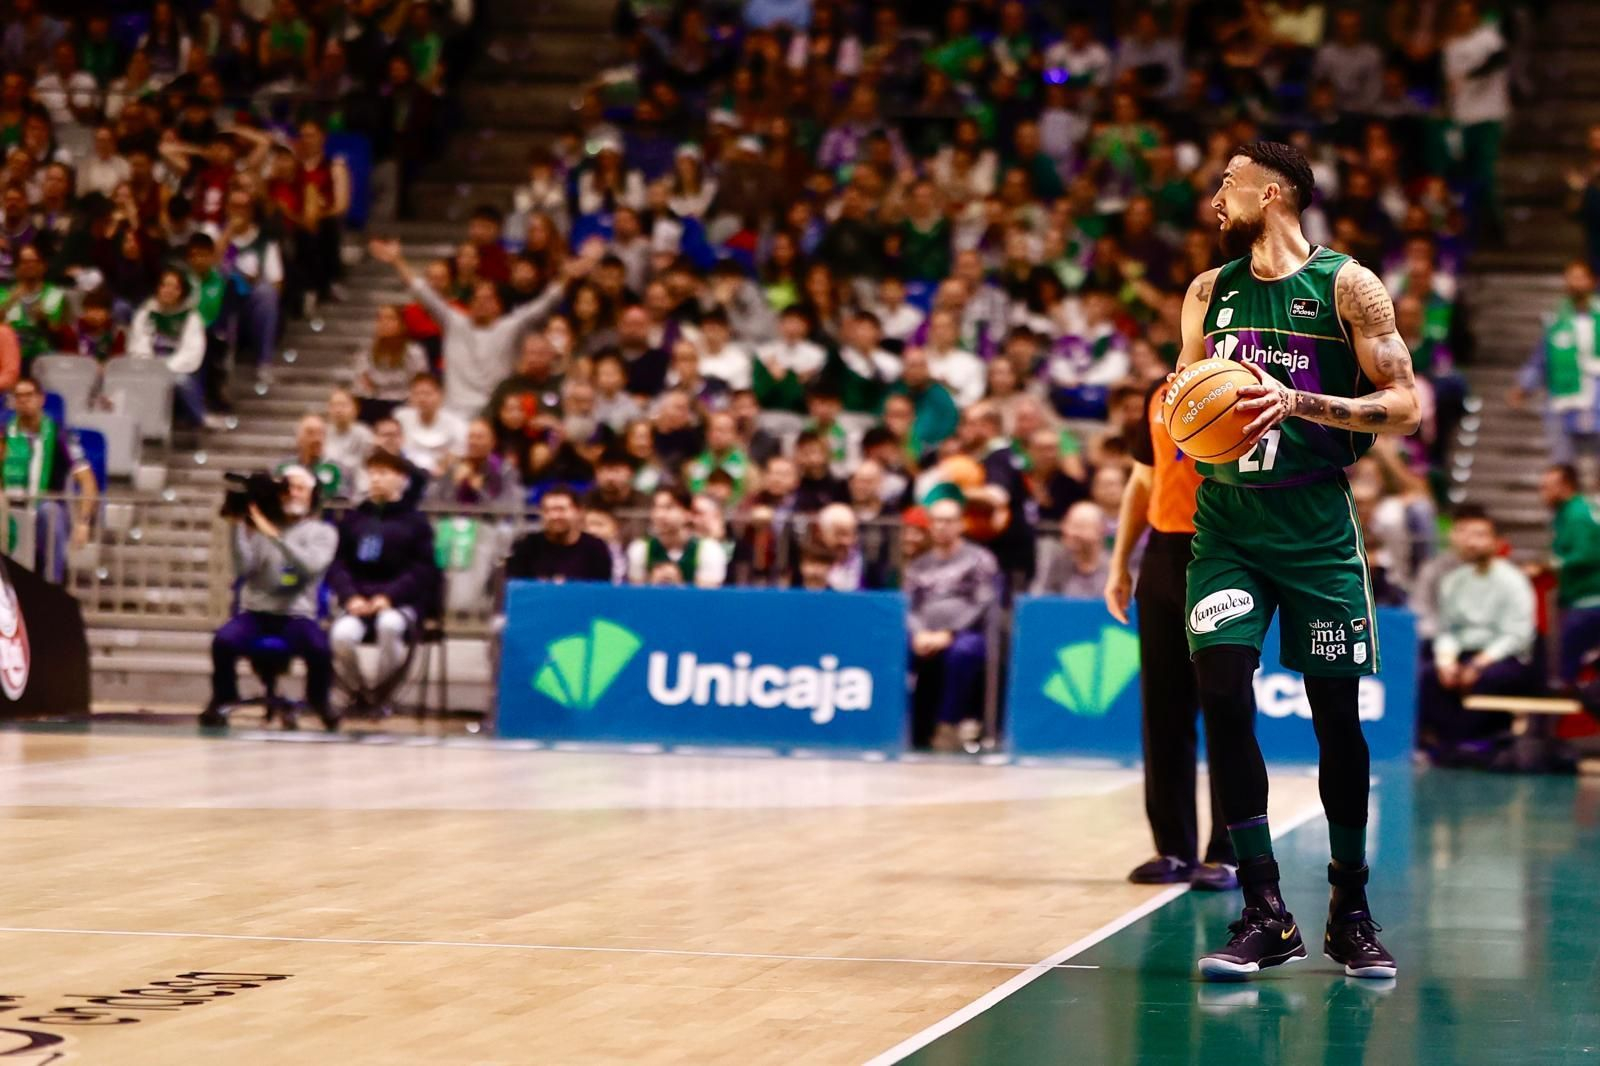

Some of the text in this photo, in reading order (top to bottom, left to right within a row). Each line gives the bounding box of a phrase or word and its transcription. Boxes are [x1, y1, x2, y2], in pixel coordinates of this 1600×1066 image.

[1242, 344, 1309, 373] Unicaja
[1181, 381, 1234, 425] liga endesa
[1194, 593, 1251, 623] famadesa
[1308, 618, 1334, 629] sabor
[1310, 638, 1347, 661] laga
[647, 651, 873, 725] Unicaja
